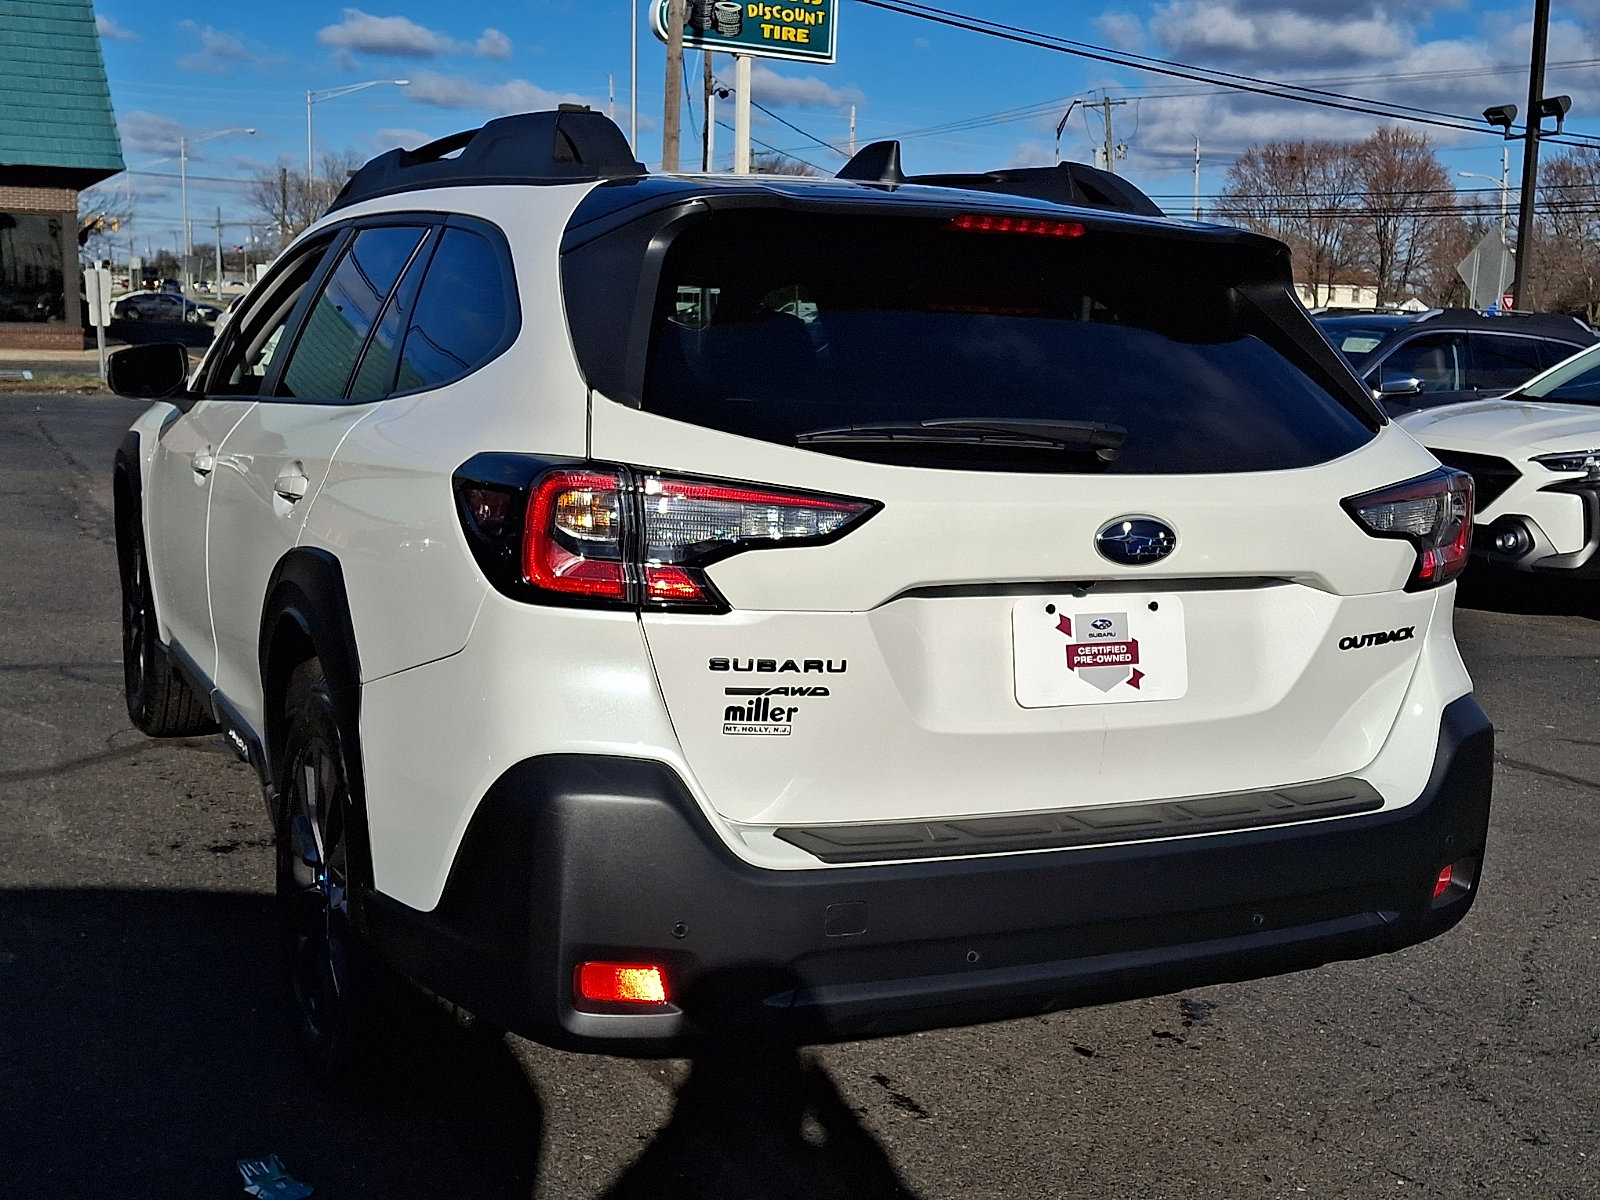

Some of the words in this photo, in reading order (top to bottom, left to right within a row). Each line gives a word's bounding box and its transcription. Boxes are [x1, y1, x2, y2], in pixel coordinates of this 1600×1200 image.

[747, 2, 826, 26] DISCOUNT
[760, 23, 810, 43] TIRE
[1338, 625, 1416, 650] OUTBACK
[1073, 654, 1132, 664] PRE-OWNED
[1077, 645, 1127, 655] CERTIFIED
[709, 657, 847, 673] SUBARU
[764, 686, 830, 697] AWD
[724, 696, 799, 722] miller
